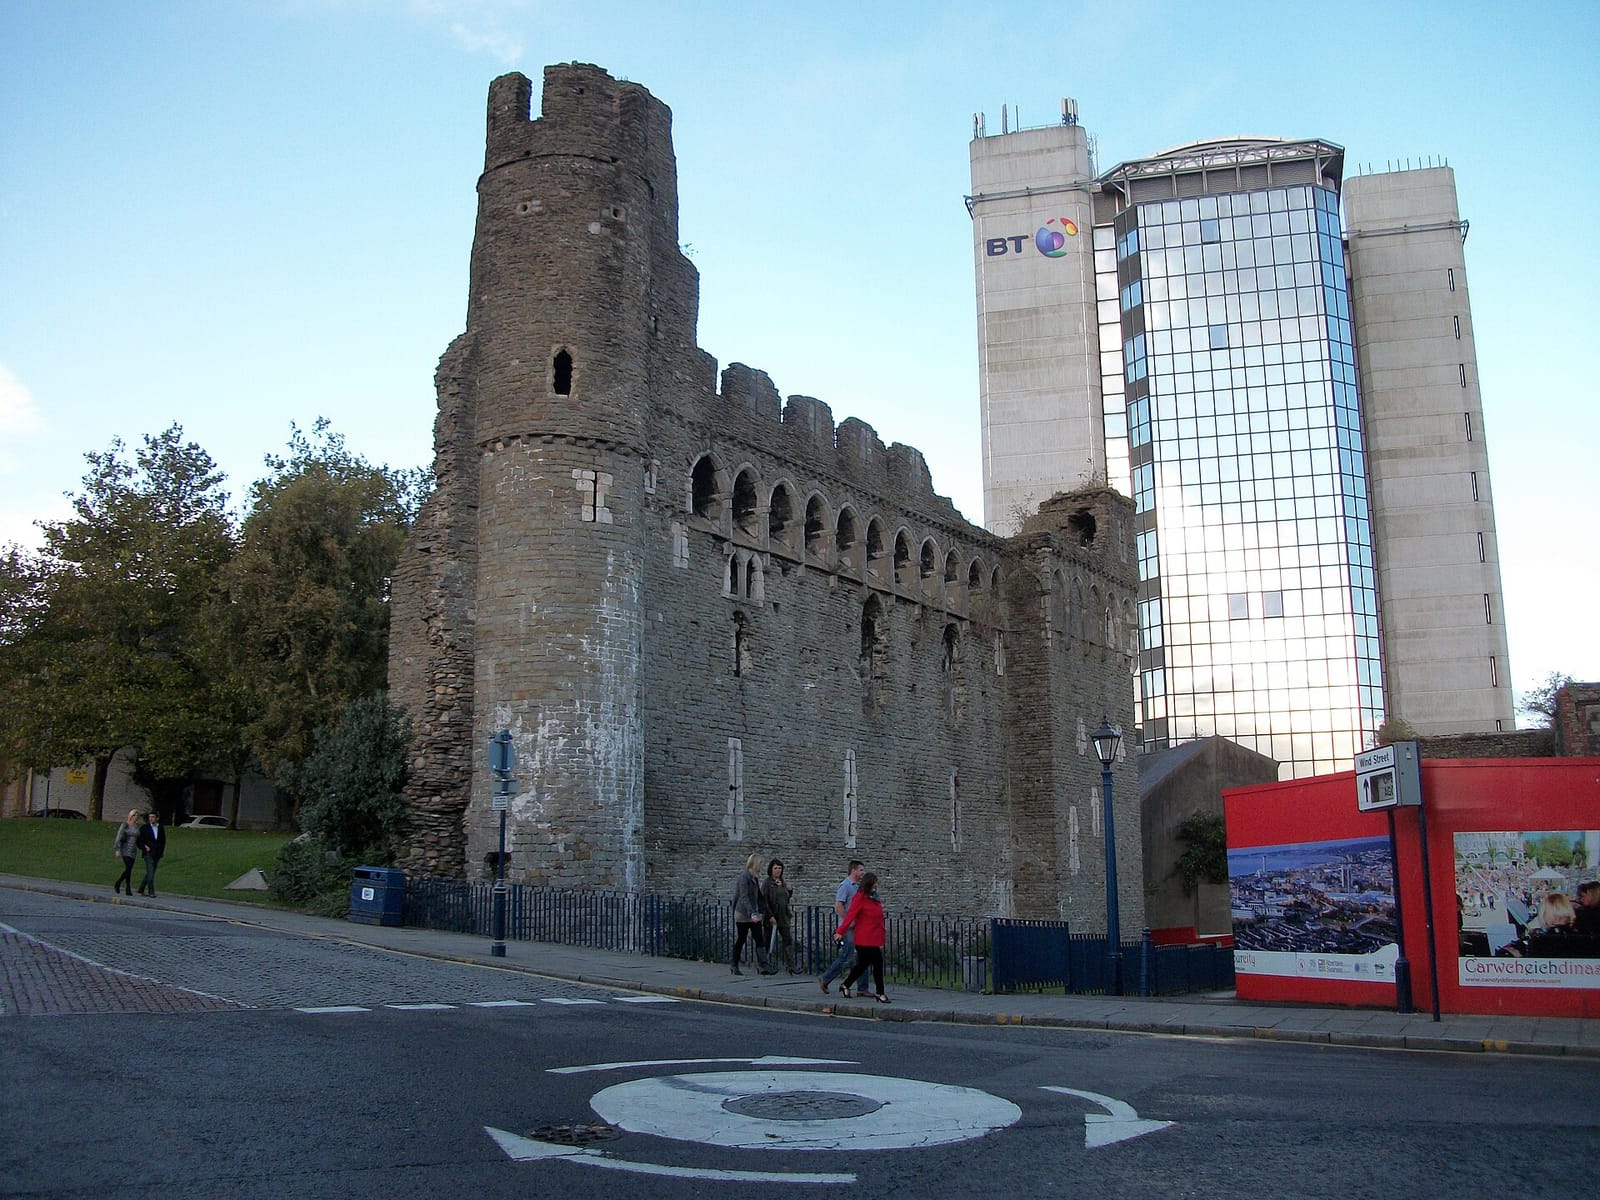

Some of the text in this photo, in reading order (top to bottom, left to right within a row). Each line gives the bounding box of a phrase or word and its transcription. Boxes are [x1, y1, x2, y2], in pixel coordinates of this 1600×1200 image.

[987, 235, 1029, 256] BT
[1359, 753, 1389, 768] Wind Street
